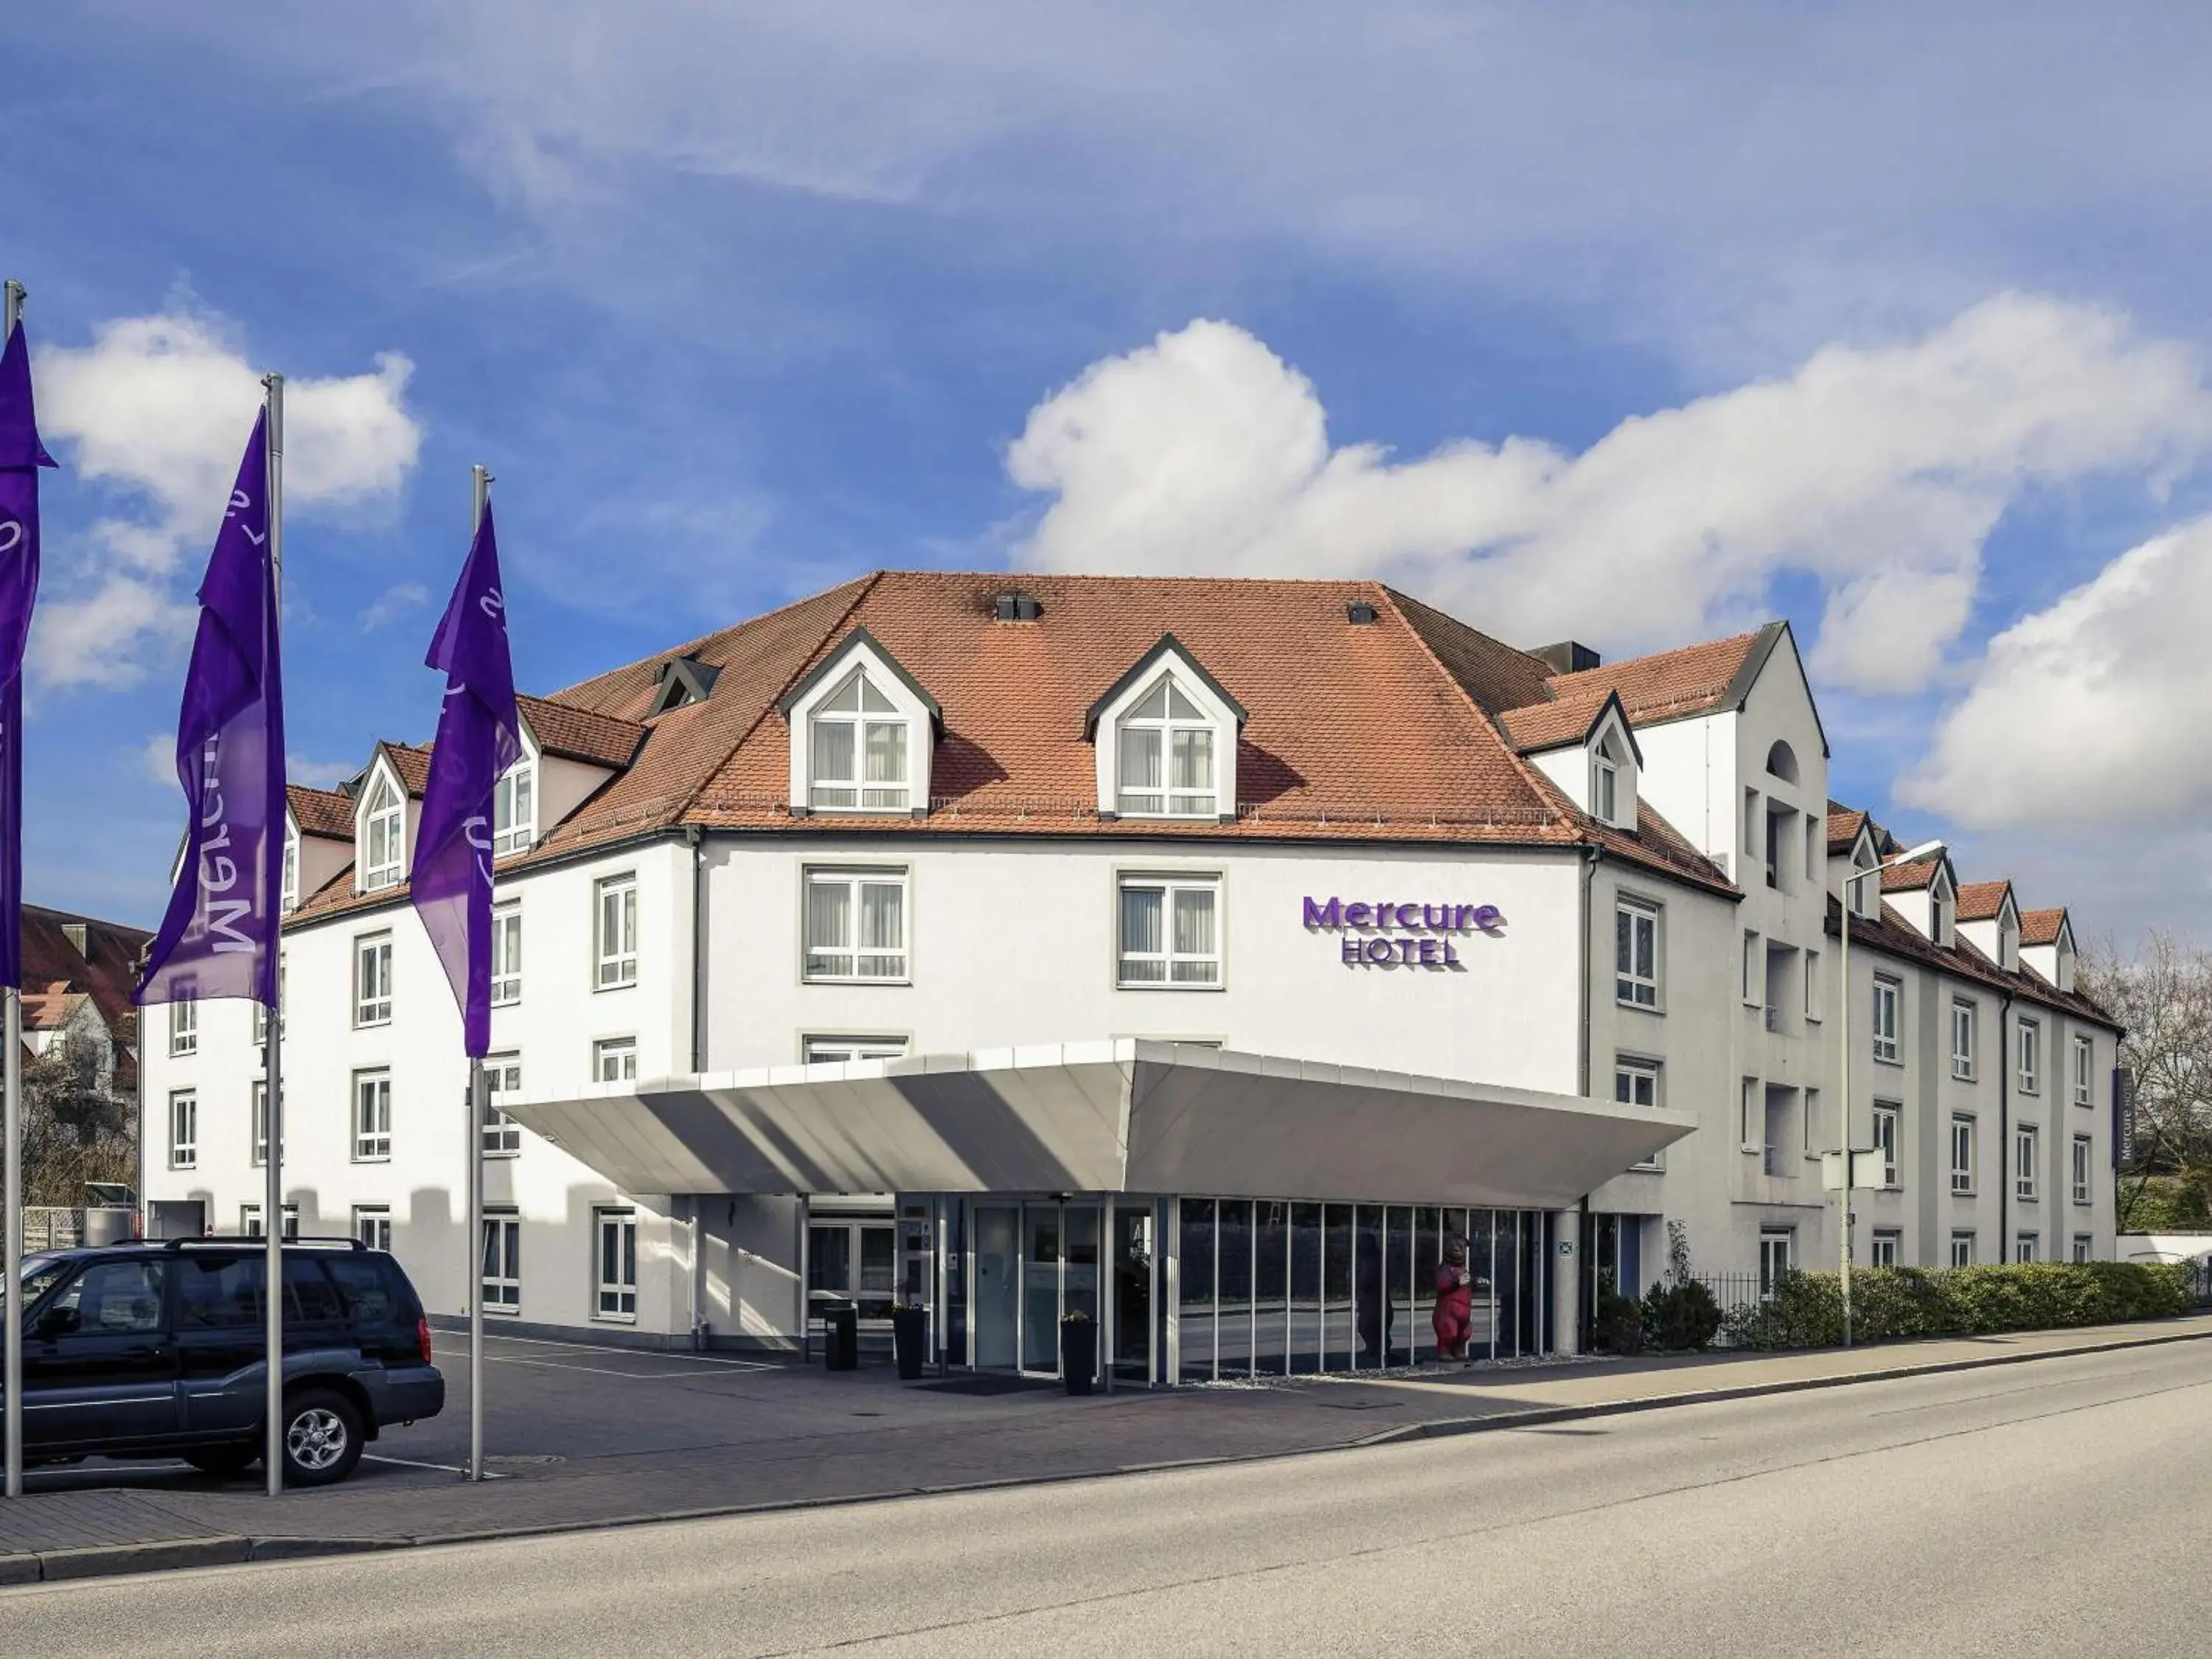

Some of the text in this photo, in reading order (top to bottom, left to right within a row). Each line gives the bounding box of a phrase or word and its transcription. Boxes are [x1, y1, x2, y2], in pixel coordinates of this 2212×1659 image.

[1303, 896, 1500, 930] Mercure
[1341, 937, 1460, 964] HOTEL
[2121, 1108, 2132, 1161] Mercure
